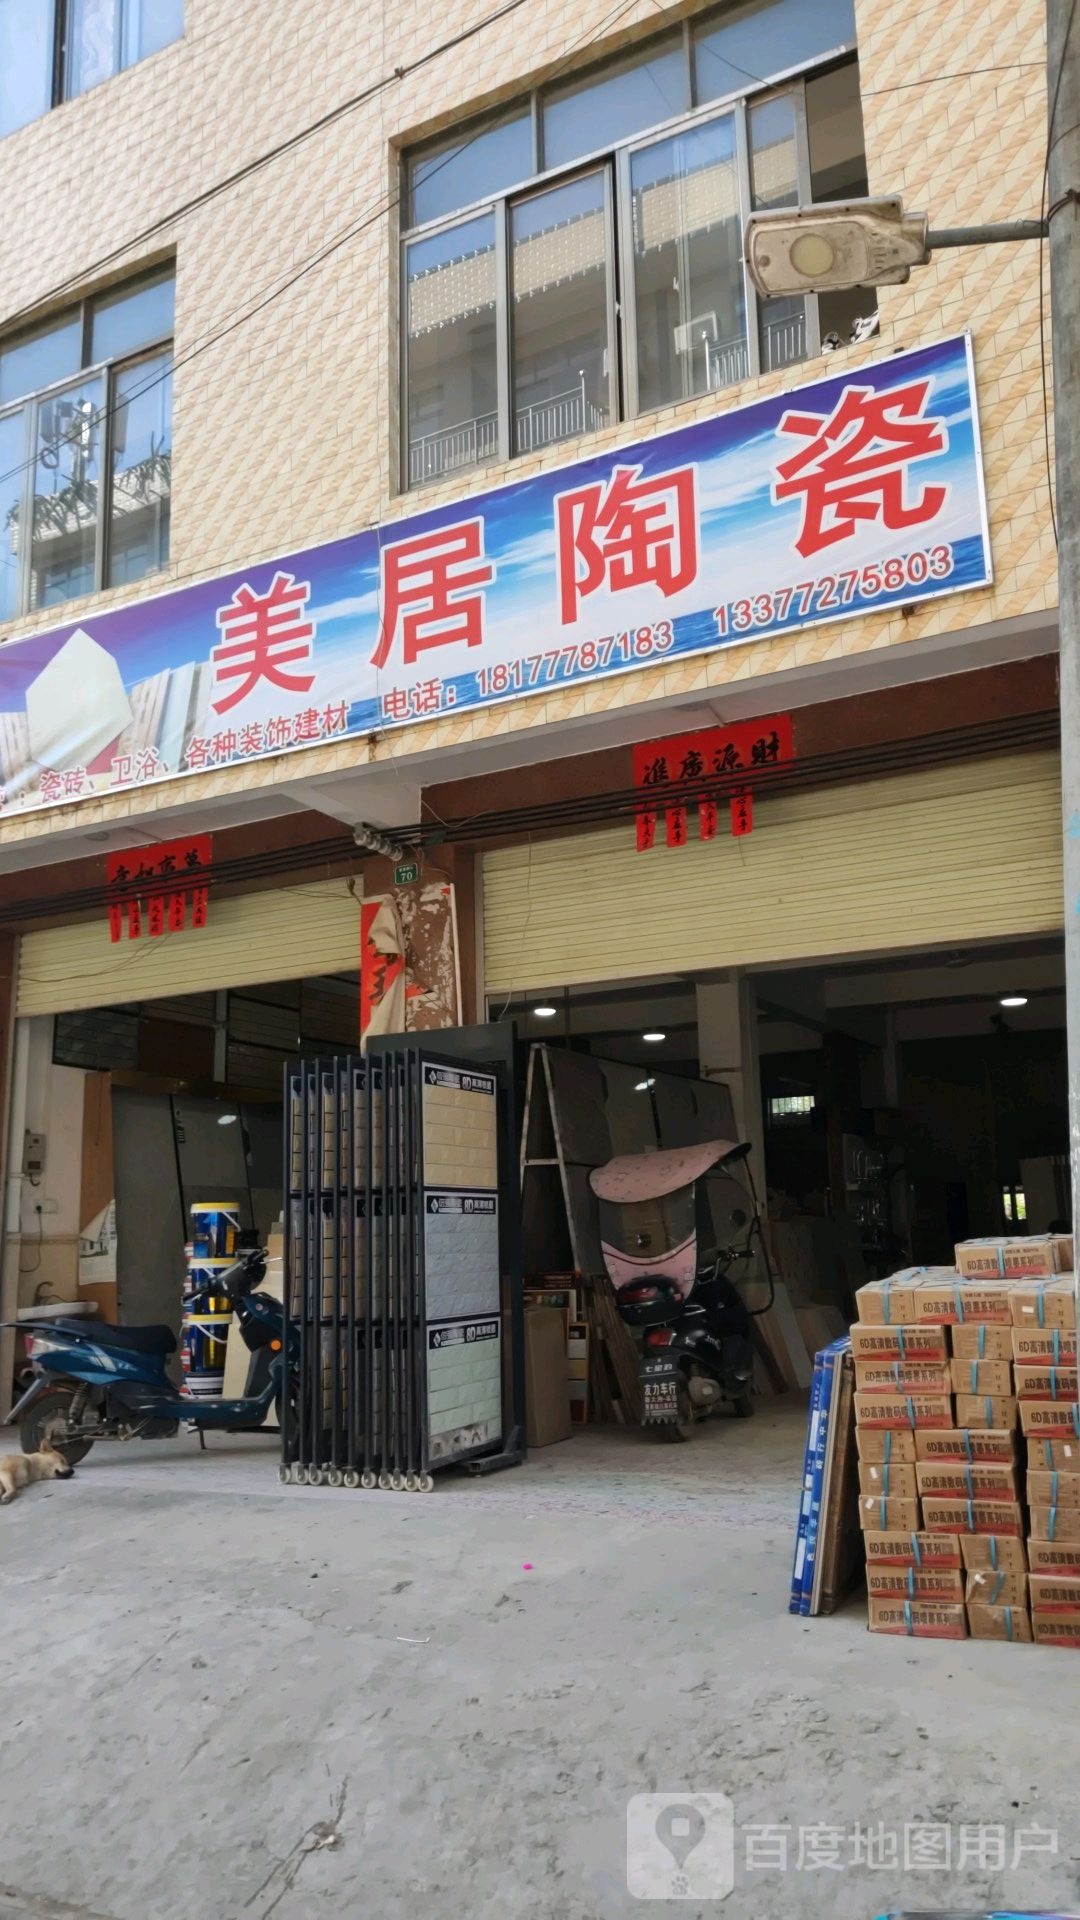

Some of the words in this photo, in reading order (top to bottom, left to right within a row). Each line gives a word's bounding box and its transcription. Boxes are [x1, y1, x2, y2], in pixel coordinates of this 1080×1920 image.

[211, 381, 949, 713] 美居陶瓷
[714, 545, 952, 634] 13377275803
[400, 871, 413, 882] 70
